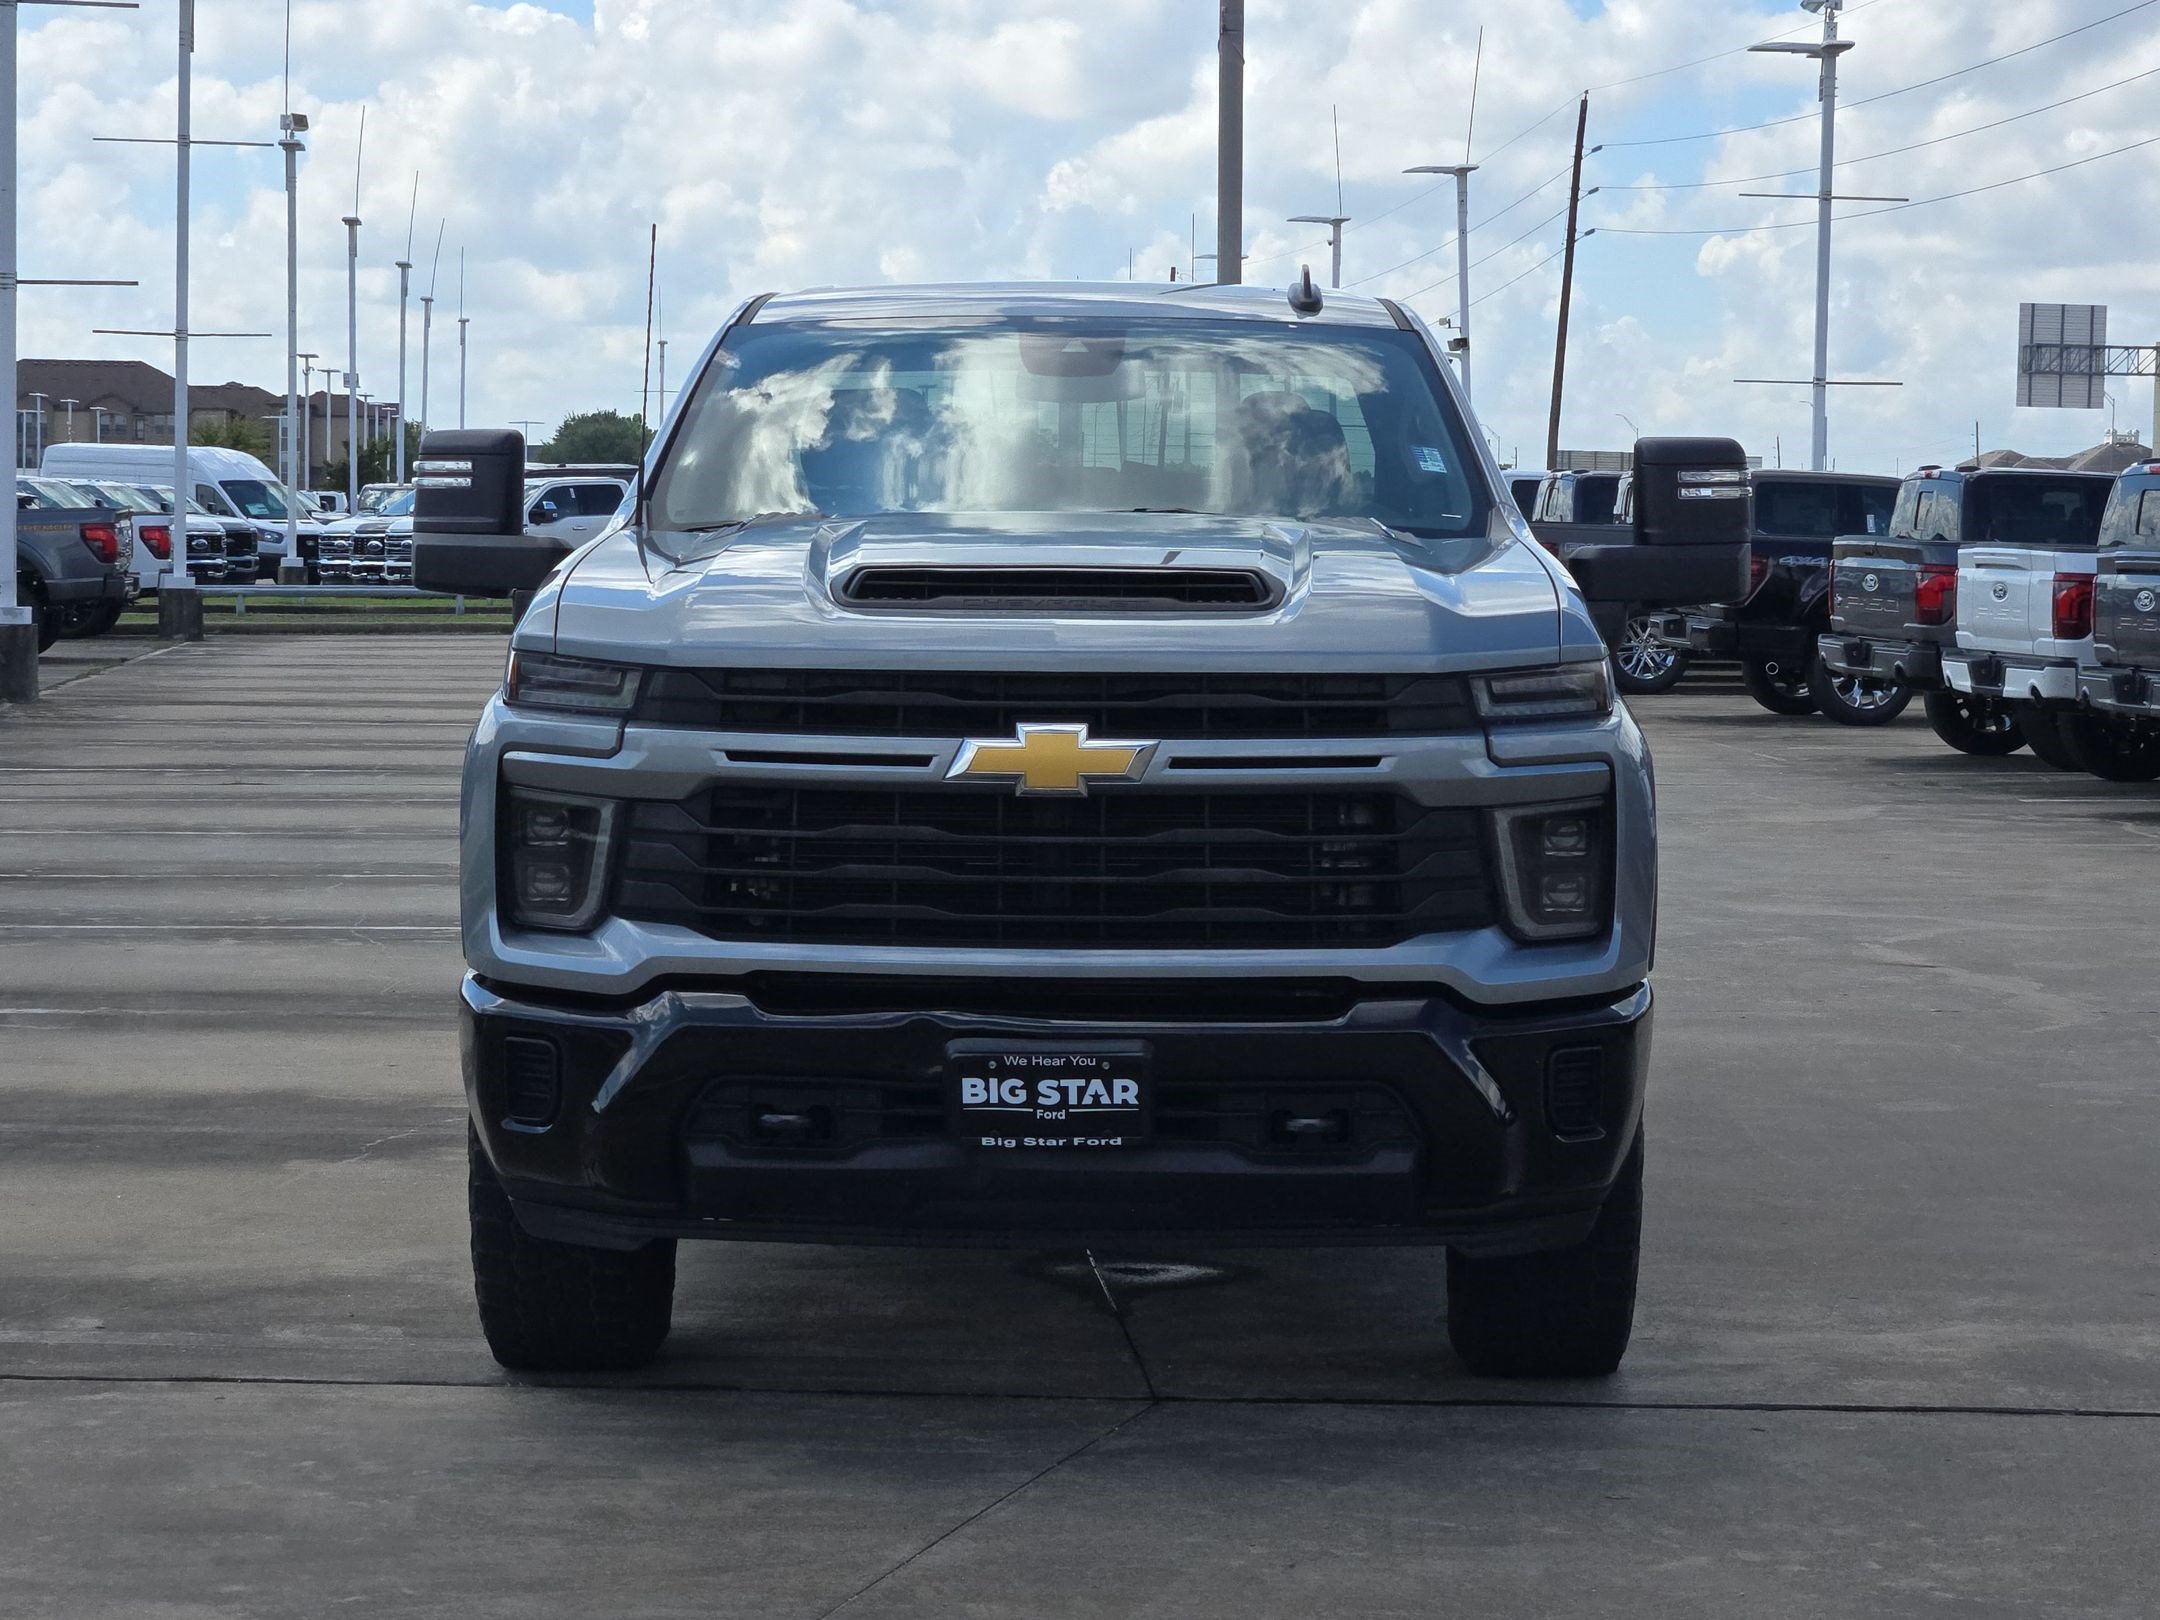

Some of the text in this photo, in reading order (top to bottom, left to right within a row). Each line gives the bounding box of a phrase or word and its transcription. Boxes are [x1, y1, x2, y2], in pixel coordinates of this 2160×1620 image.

[962, 598, 1152, 608] CHEVROLET
[1003, 1055, 1096, 1066] We Hear You
[961, 1077, 1139, 1106] BIG STAR
[1036, 1109, 1066, 1120] Ford
[981, 1137, 1122, 1148] Big Star Ford
